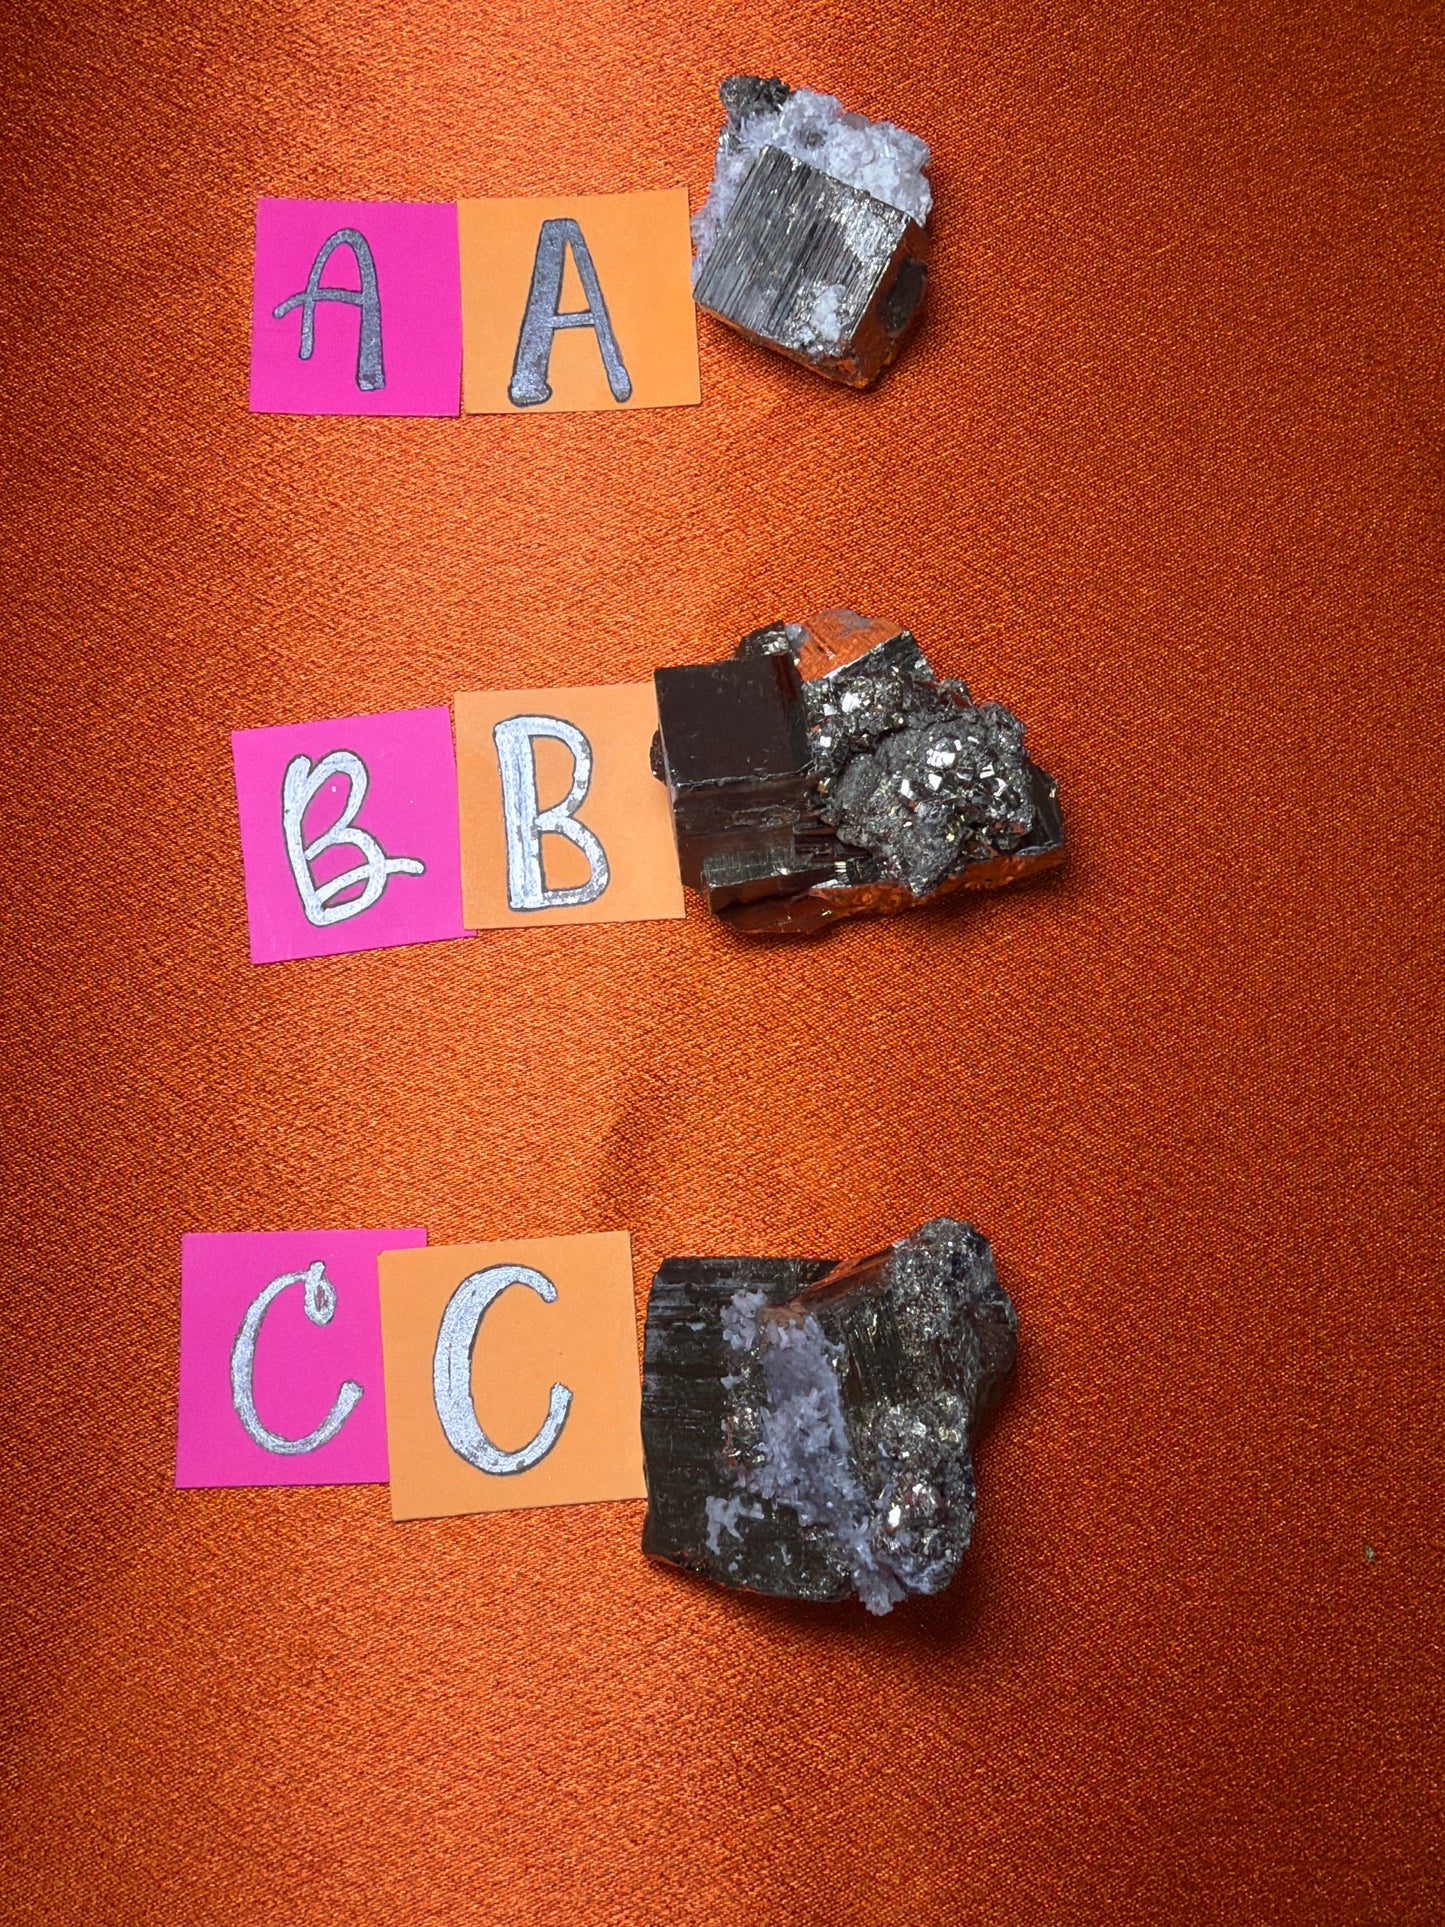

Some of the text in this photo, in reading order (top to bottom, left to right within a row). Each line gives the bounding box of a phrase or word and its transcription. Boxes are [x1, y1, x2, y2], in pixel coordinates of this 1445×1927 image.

[272, 227, 385, 392] A
[508, 217, 632, 407] A
[281, 749, 426, 928] B
[493, 714, 610, 912] B
[230, 1261, 364, 1456] C
[433, 1263, 573, 1476] C
